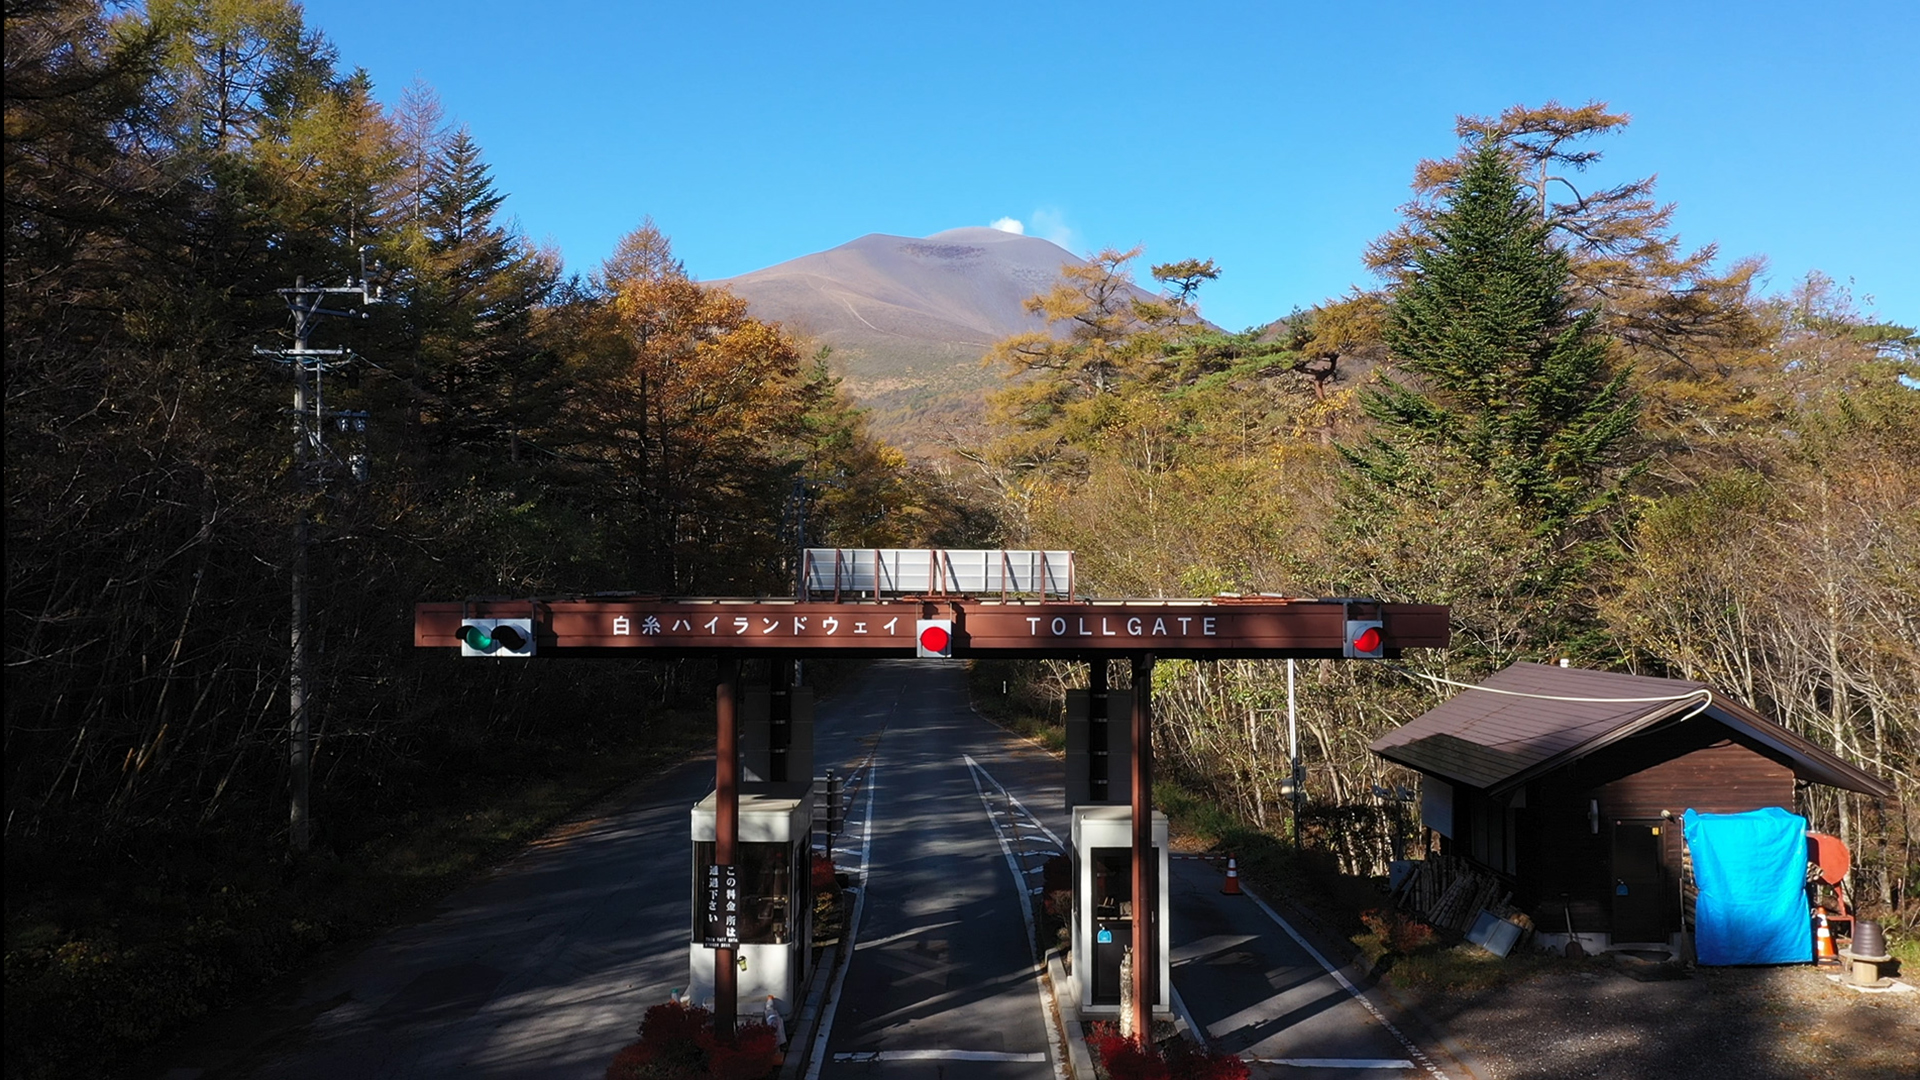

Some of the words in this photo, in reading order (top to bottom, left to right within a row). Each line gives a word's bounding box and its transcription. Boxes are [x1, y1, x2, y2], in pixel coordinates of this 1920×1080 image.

[612, 616, 899, 635] 白糸ハイランドウェイ
[1026, 617, 1216, 636] TOLLGATE
[726, 866, 737, 937] この料金所は
